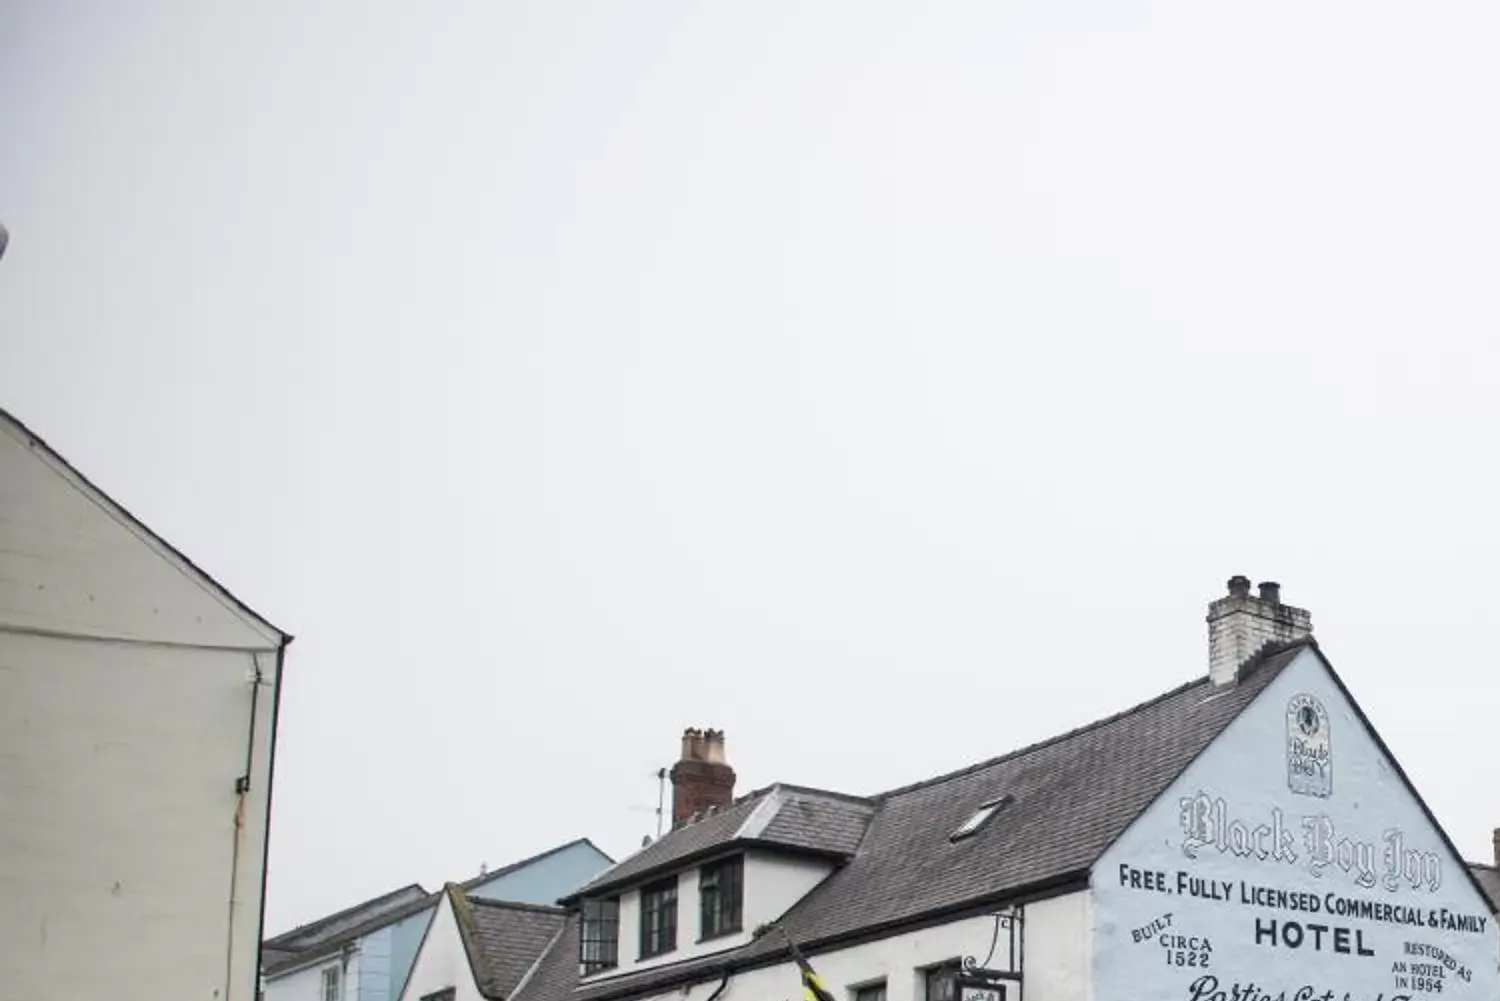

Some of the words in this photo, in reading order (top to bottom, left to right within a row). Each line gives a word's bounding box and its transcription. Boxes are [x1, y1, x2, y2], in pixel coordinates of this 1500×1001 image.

[1179, 789, 1299, 864] Black
[1301, 815, 1377, 889] Boy
[1382, 828, 1443, 893] Inn
[1177, 871, 1233, 901] FULLY
[1241, 881, 1320, 913] LICENSED
[1325, 892, 1425, 928] COMMERCIAL
[1428, 911, 1440, 928] &
[1440, 907, 1488, 934] FAMILY
[1131, 912, 1174, 943] BUILT
[1159, 933, 1213, 952] CIRCA
[1255, 917, 1376, 958] HOTEL
[1167, 949, 1210, 968] 1522
[1392, 960, 1408, 974] AN
[1411, 963, 1447, 979] HOTEL
[1404, 941, 1457, 972] RESTORED
[1457, 964, 1473, 984] AS
[1395, 974, 1409, 989] IN
